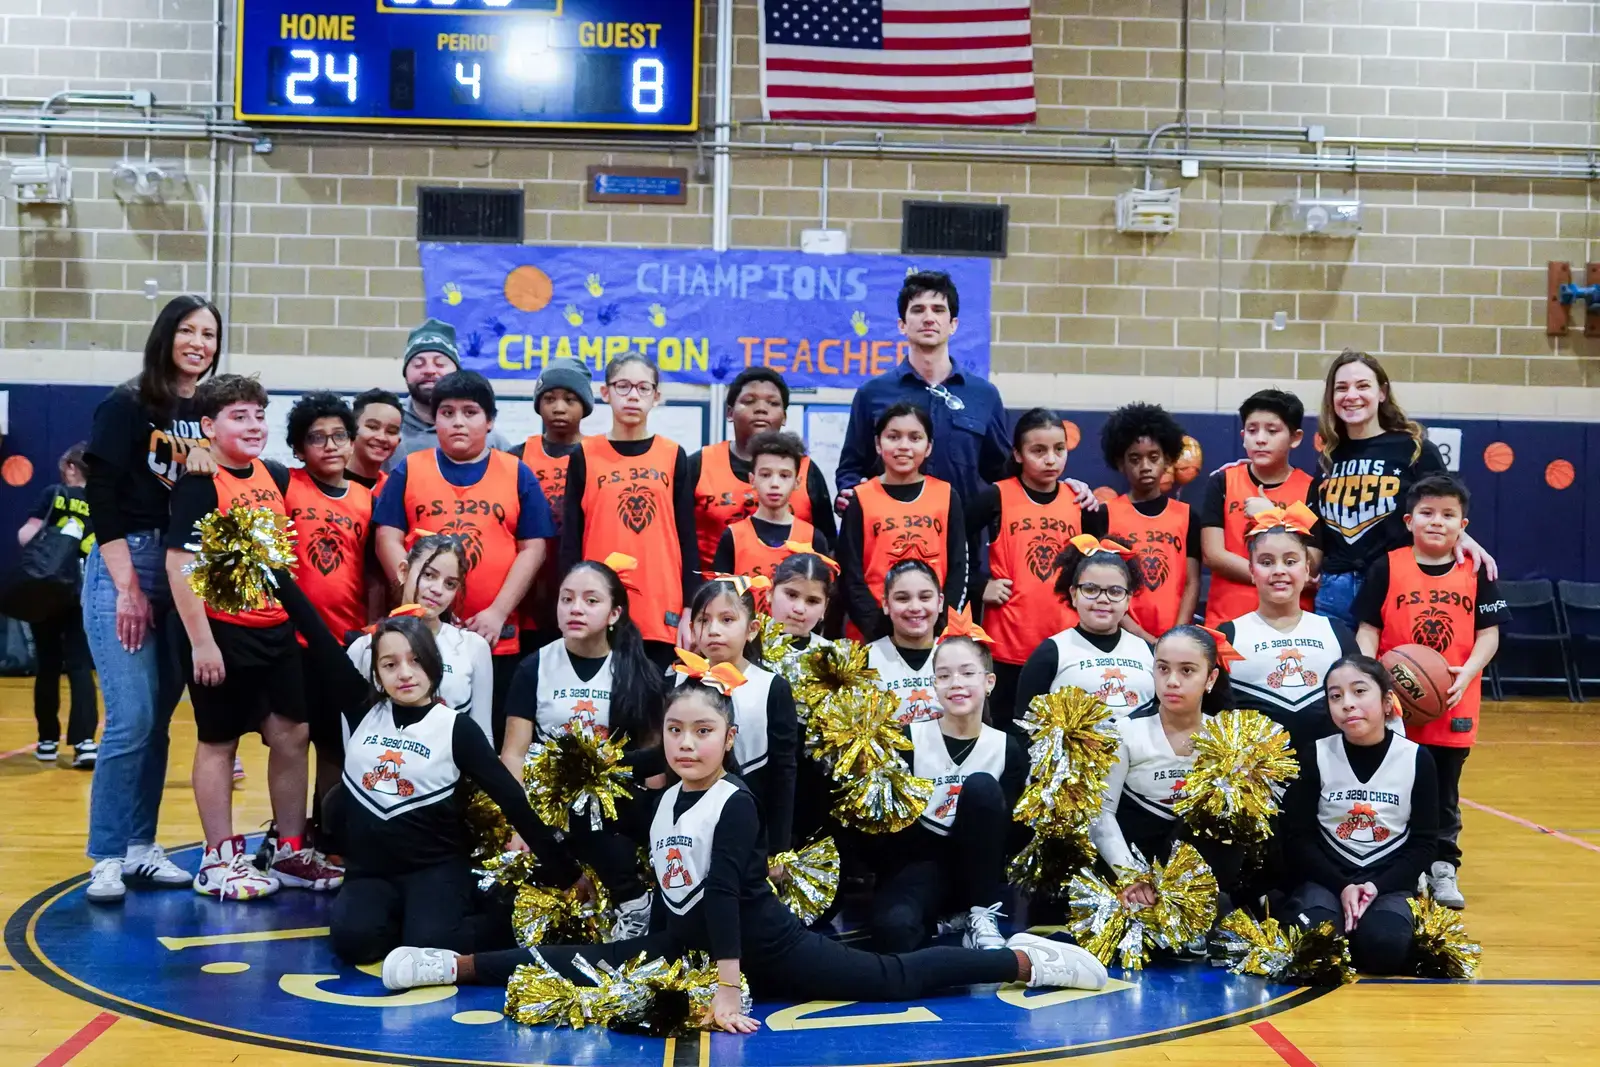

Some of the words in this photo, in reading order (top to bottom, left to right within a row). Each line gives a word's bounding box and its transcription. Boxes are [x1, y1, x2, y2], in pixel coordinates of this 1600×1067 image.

[280, 13, 356, 41] HOME
[579, 21, 662, 48] GUEST
[286, 49, 358, 104] 24
[455, 62, 481, 99] 4
[632, 58, 664, 113] 8
[636, 262, 868, 301] CHAMPIONS
[1331, 459, 1385, 478] LIONS
[597, 470, 625, 489] P.S.
[415, 499, 448, 522] P.S.
[1318, 475, 1401, 529] CHEER
[873, 517, 900, 537] P.S.
[1010, 518, 1036, 536] P.S.
[1396, 590, 1424, 609] P.S.
[1254, 641, 1270, 653] P.S.
[1294, 638, 1325, 650] CHEER
[1116, 658, 1144, 671] CHEER
[1390, 663, 1426, 700] NCAA
[553, 689, 568, 700] P.S.
[591, 689, 612, 700] CHE
[402, 739, 431, 760] CHEER
[1328, 792, 1344, 803] P.S.
[1369, 791, 1400, 806] CHEER
